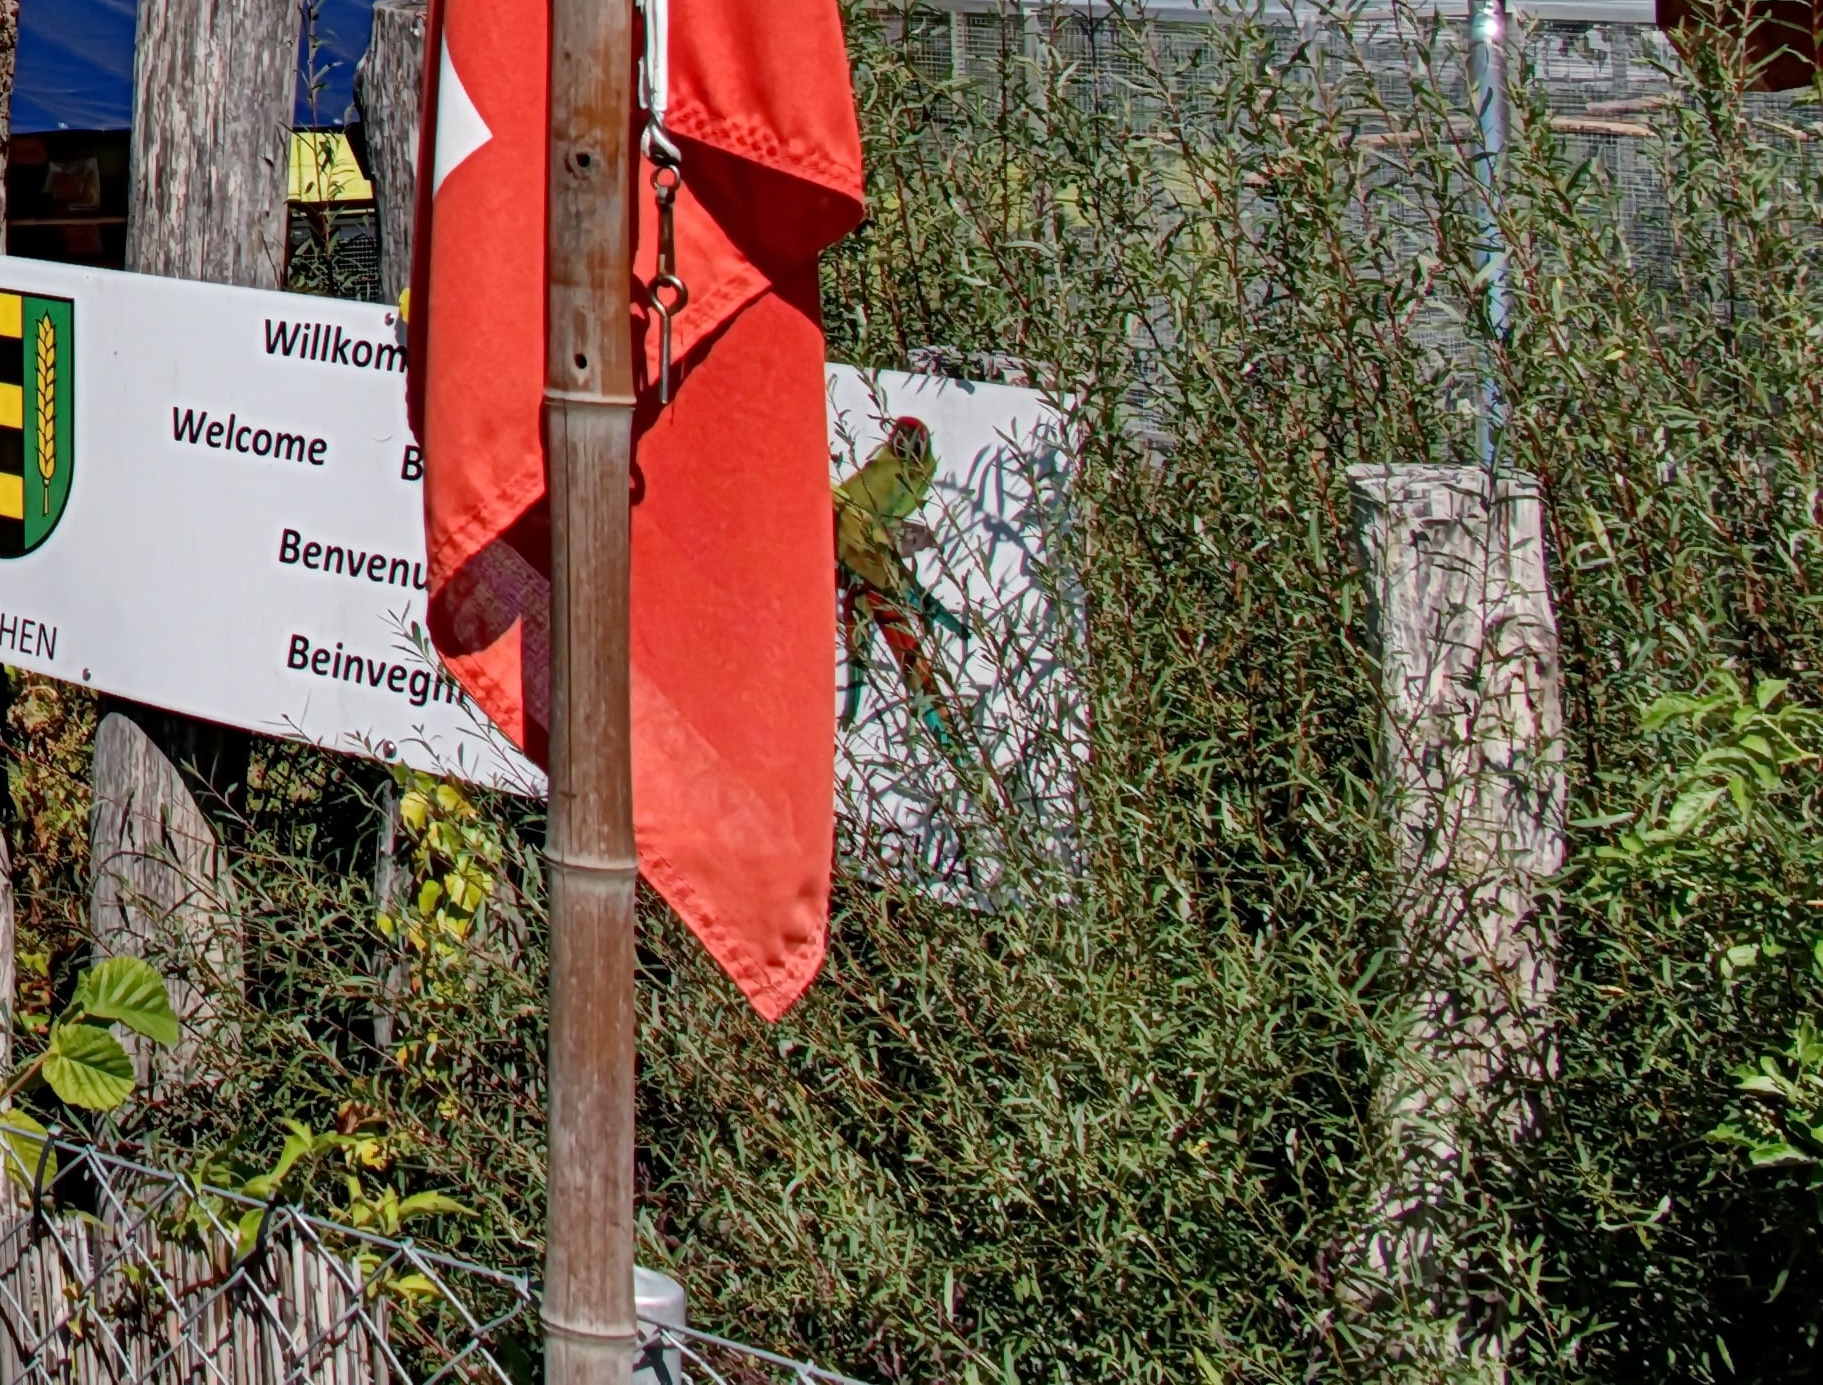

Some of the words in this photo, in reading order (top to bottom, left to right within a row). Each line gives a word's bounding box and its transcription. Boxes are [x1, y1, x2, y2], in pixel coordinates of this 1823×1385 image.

[264, 318, 408, 373] Willkom
[172, 406, 328, 466] Welcome
[278, 528, 429, 591] Benvenu
[287, 633, 465, 707] Beinvegn
